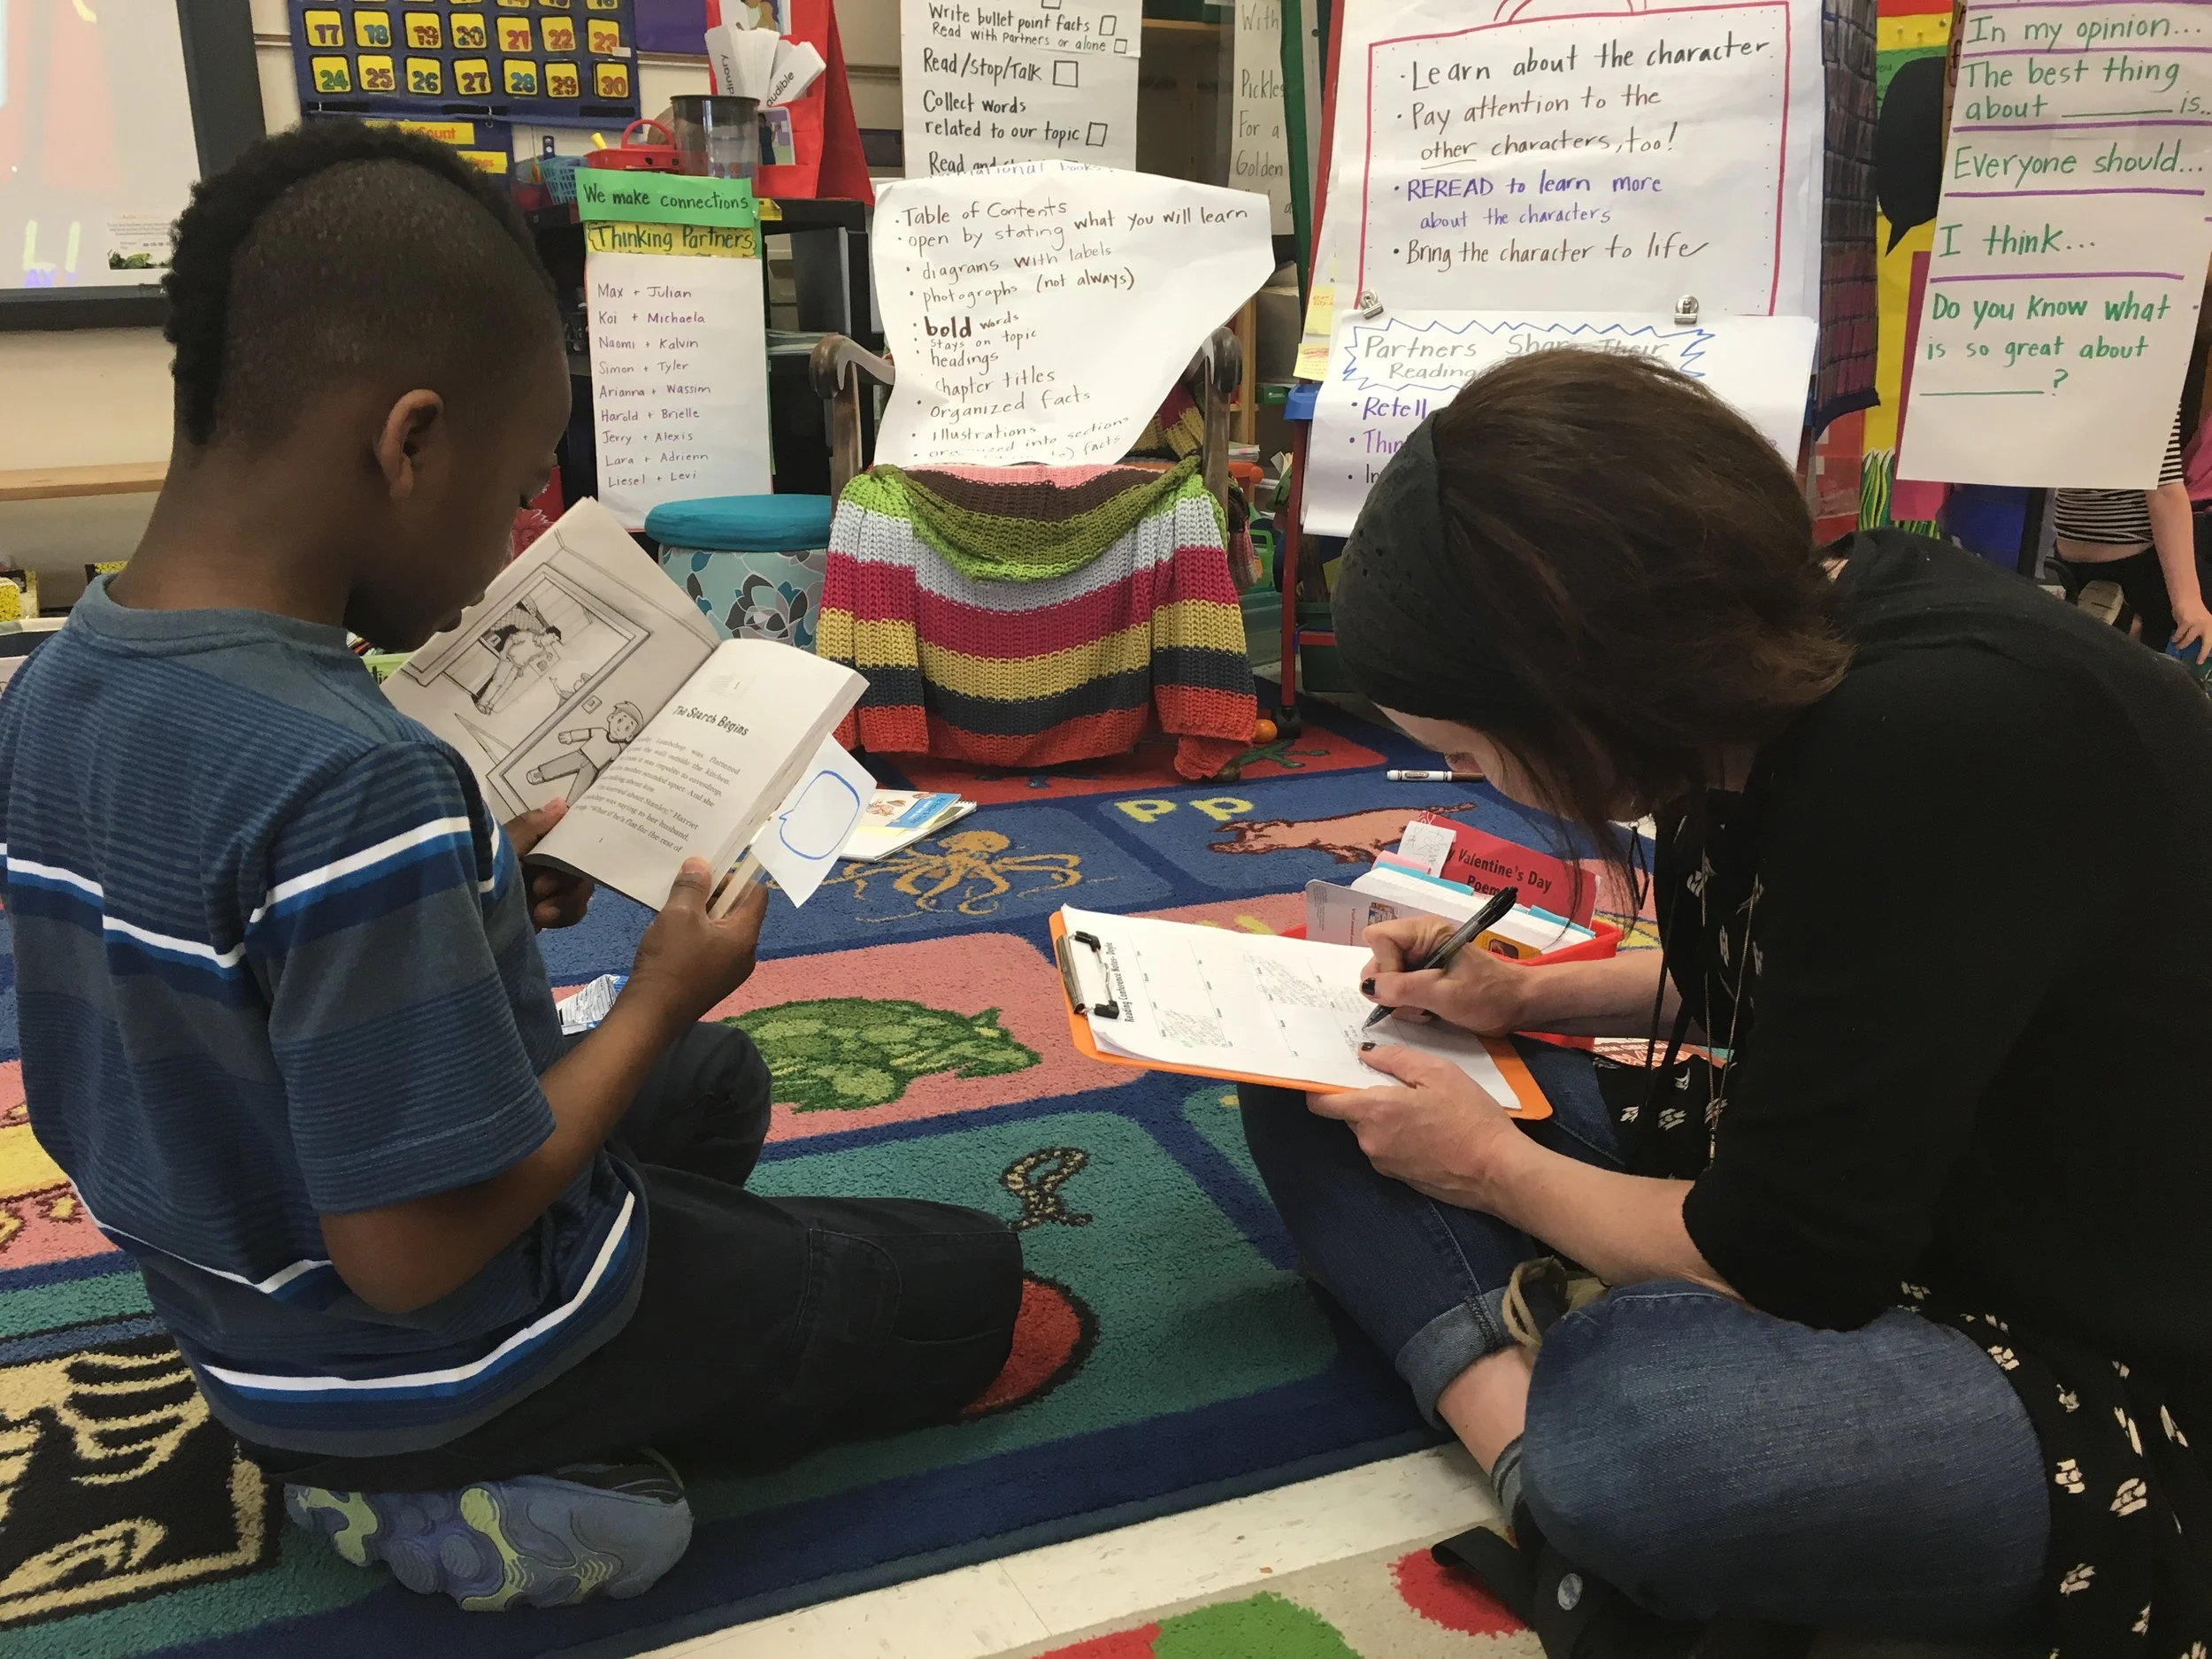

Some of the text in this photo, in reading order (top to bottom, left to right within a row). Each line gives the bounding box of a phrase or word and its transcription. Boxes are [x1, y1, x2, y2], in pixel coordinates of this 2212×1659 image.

[929, 2, 1090, 33] Write bullet point facts
[1241, 3, 1279, 31] With
[314, 23, 618, 54] 17 18 19 20 21 22 23
[933, 22, 961, 38] Read
[971, 27, 997, 42] with
[1058, 38, 1069, 48] or
[1075, 35, 1106, 52] alone
[1967, 16, 2006, 44] In
[2024, 23, 2062, 53] my
[1412, 31, 1770, 91] Learn about the character
[1961, 55, 2180, 93] The best thing
[319, 67, 626, 97] 24 25 26 27 28 29 30
[766, 71, 795, 107] audible
[1240, 69, 1284, 99] Pickles
[923, 89, 1026, 113] Collect words
[1412, 83, 1663, 135] Pay attention to the
[1966, 94, 2048, 121] about
[926, 118, 1080, 149] related to our topic
[1239, 110, 1279, 138] For a
[929, 151, 964, 175] Read
[1235, 150, 1283, 177] Golden
[1420, 140, 1478, 163] other
[1955, 146, 2077, 188] Everyone
[584, 183, 749, 210] We make connections
[1407, 169, 1663, 203] REREAD to learn more
[902, 197, 1067, 228] Table of Contents
[1420, 202, 1611, 230] about the characters
[597, 224, 754, 250] Thinking Partners
[908, 207, 1248, 257] open by stating what you will learn
[1939, 224, 1962, 257] I
[922, 242, 1111, 286] diagrams with labels
[1407, 231, 1709, 273] Bring the character to life
[597, 284, 692, 299] Max Julian
[923, 266, 1135, 311] photographs (not always)
[647, 311, 705, 324] Michaela
[1932, 293, 1961, 320] Do
[1973, 300, 2015, 330] you
[2105, 290, 2172, 322] what
[924, 312, 1019, 338] bold words
[599, 336, 699, 349] Naomi Kalvin
[975, 338, 991, 349] on
[1001, 328, 1038, 351] topic
[1364, 335, 1477, 358] Partners
[1927, 334, 2149, 367] is so great about
[599, 360, 688, 376] Simon Tyler
[930, 349, 999, 376] headings
[1002, 365, 1056, 388] titles
[599, 384, 711, 399] Arianna Wassim
[1041, 384, 1091, 410] facts
[601, 408, 700, 423] Harold Brielle
[1363, 396, 1427, 420] Retell
[602, 430, 694, 445] Jerry Alexis
[1025, 435, 1056, 447] into
[605, 456, 634, 467] Lara
[609, 470, 697, 488] Liesel Levi
[687, 707, 718, 724] Search
[717, 715, 749, 736] Begins
[1457, 848, 1525, 882] Valentine's
[1527, 870, 1553, 895] Day
[1121, 1001, 1135, 1023] Reading
